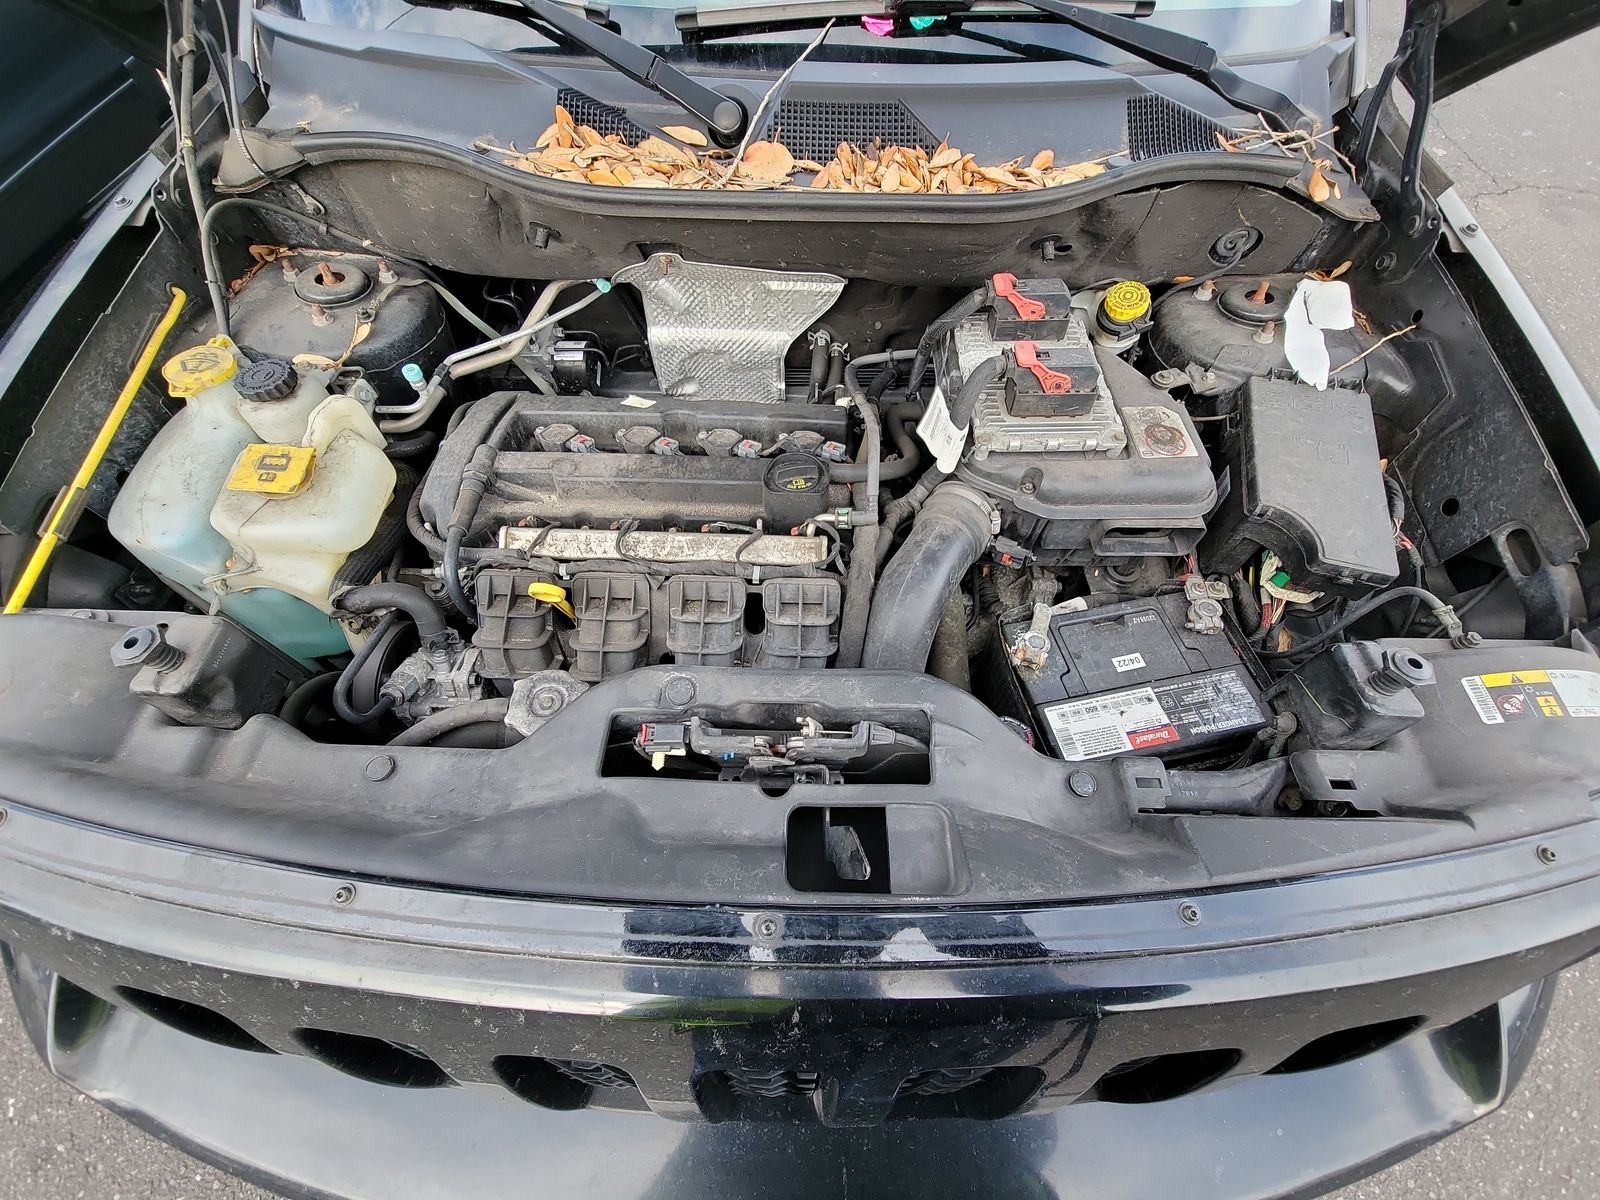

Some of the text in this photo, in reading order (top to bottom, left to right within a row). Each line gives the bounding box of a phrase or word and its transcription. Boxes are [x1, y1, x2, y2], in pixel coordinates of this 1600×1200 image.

[1116, 656, 1141, 668] 04/22
[1085, 705, 1099, 714] 650
[1135, 730, 1172, 745] Duralast
